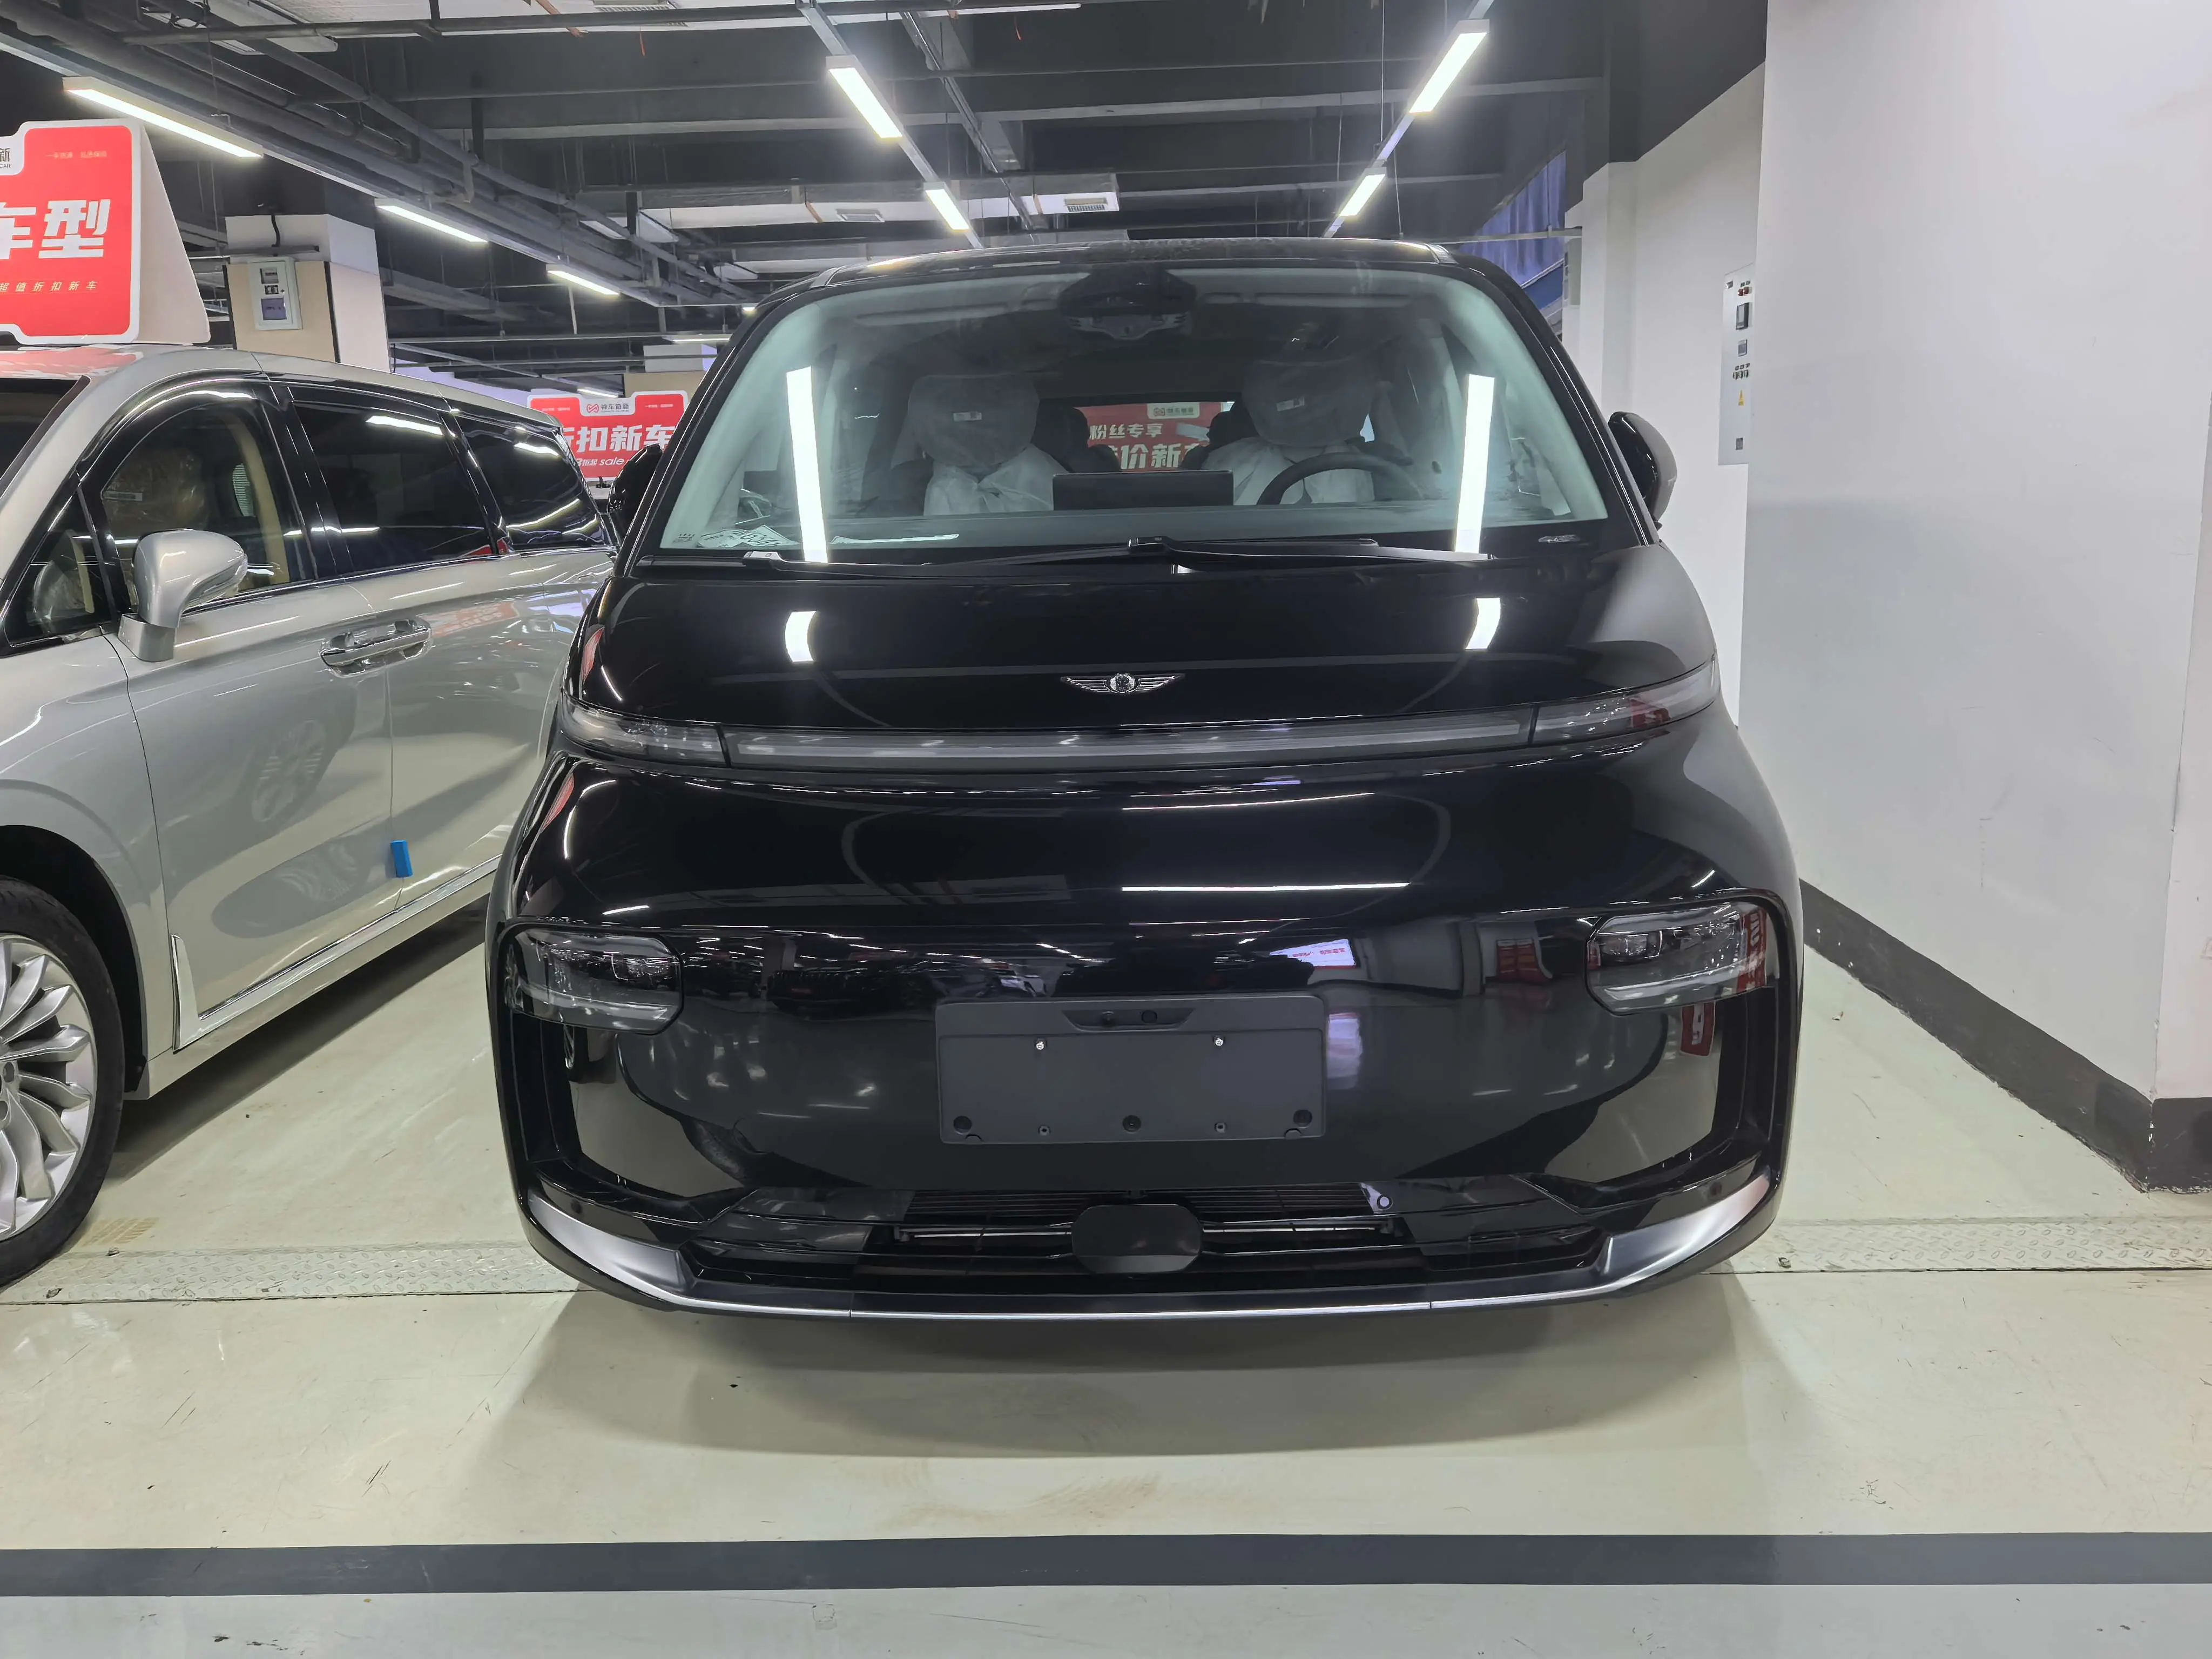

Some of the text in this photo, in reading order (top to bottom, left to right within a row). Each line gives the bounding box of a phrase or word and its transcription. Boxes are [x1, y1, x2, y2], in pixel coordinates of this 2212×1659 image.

[1089, 423, 1163, 440] 粉丝专享
[599, 456, 625, 466] sale
